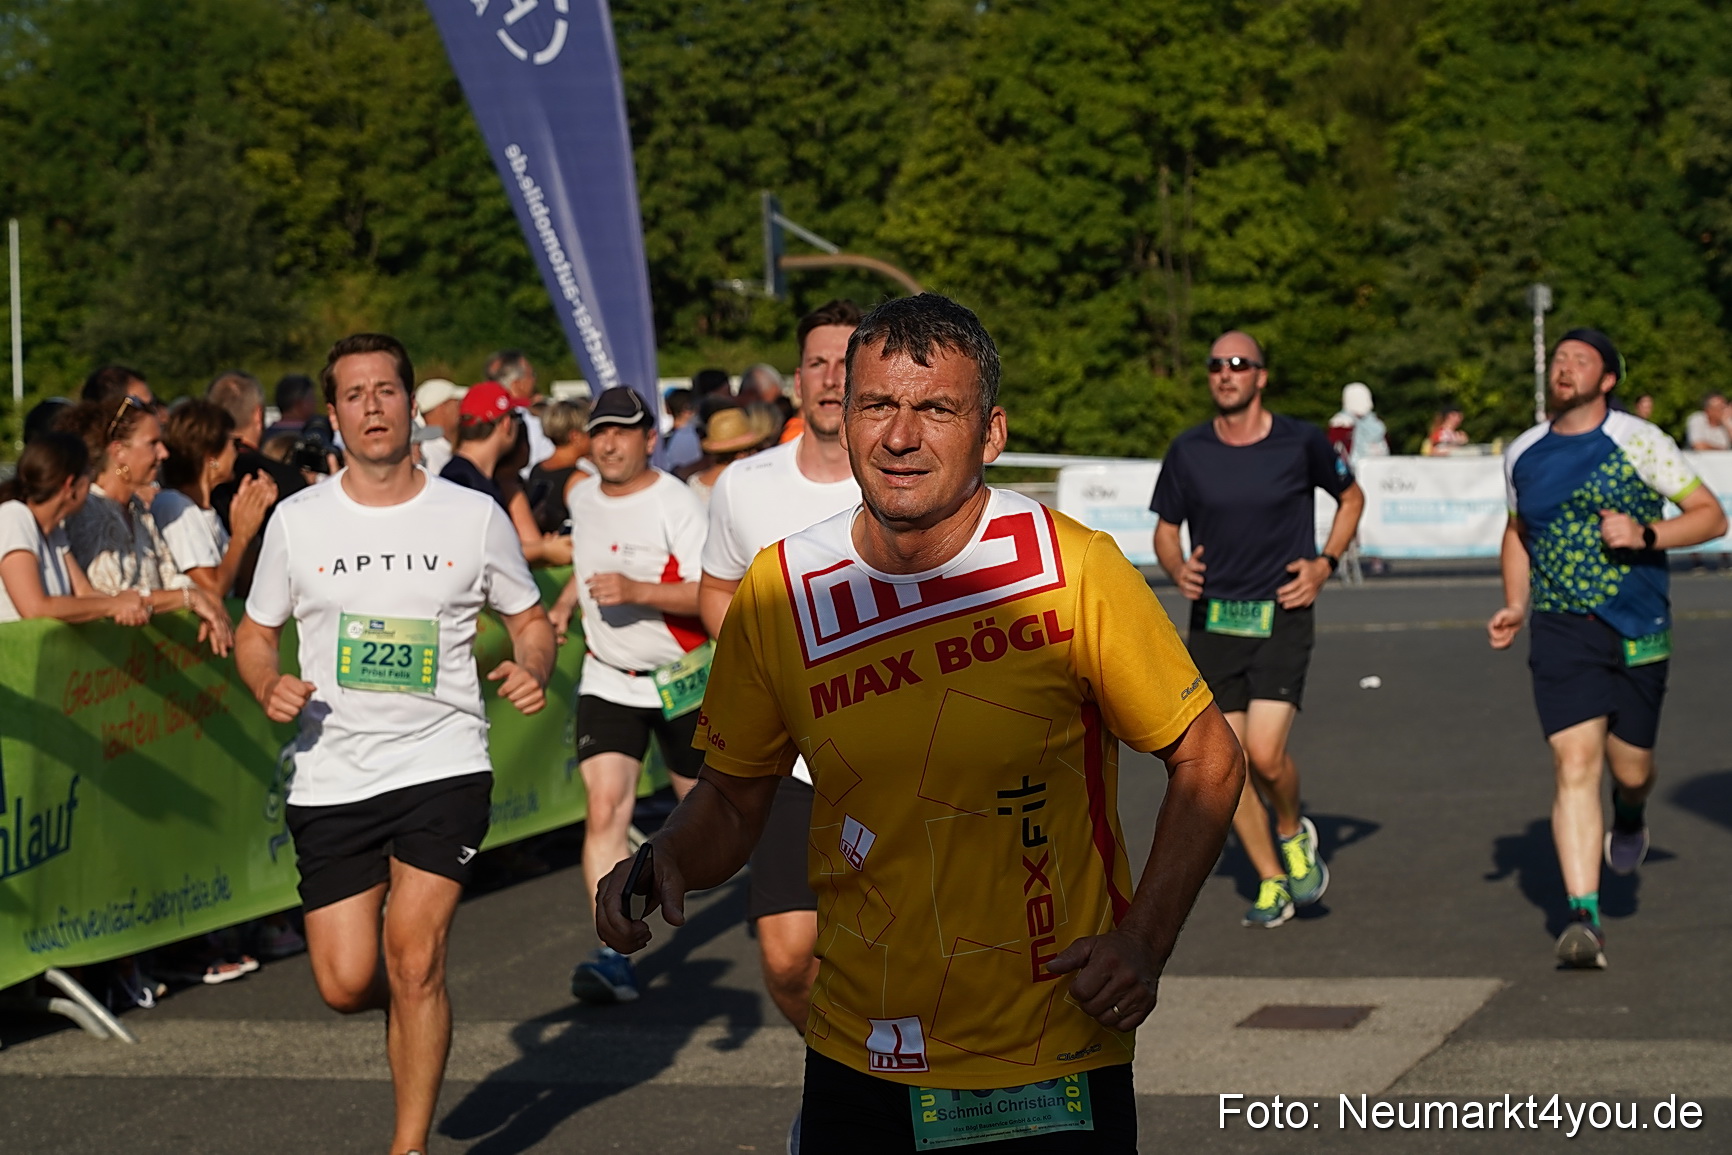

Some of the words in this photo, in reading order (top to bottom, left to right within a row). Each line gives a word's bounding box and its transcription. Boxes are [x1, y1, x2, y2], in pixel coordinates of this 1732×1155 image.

[332, 554, 439, 575] APTIV
[362, 642, 412, 667] 223
[422, 648, 433, 683] 2022
[809, 649, 924, 720] MAX
[934, 609, 1075, 676] BÖGL
[938, 1101, 993, 1122] Schmid
[997, 1094, 1066, 1117] Christian
[966, 1124, 979, 1132] Bögl
[979, 1121, 1008, 1130] Bauservice
